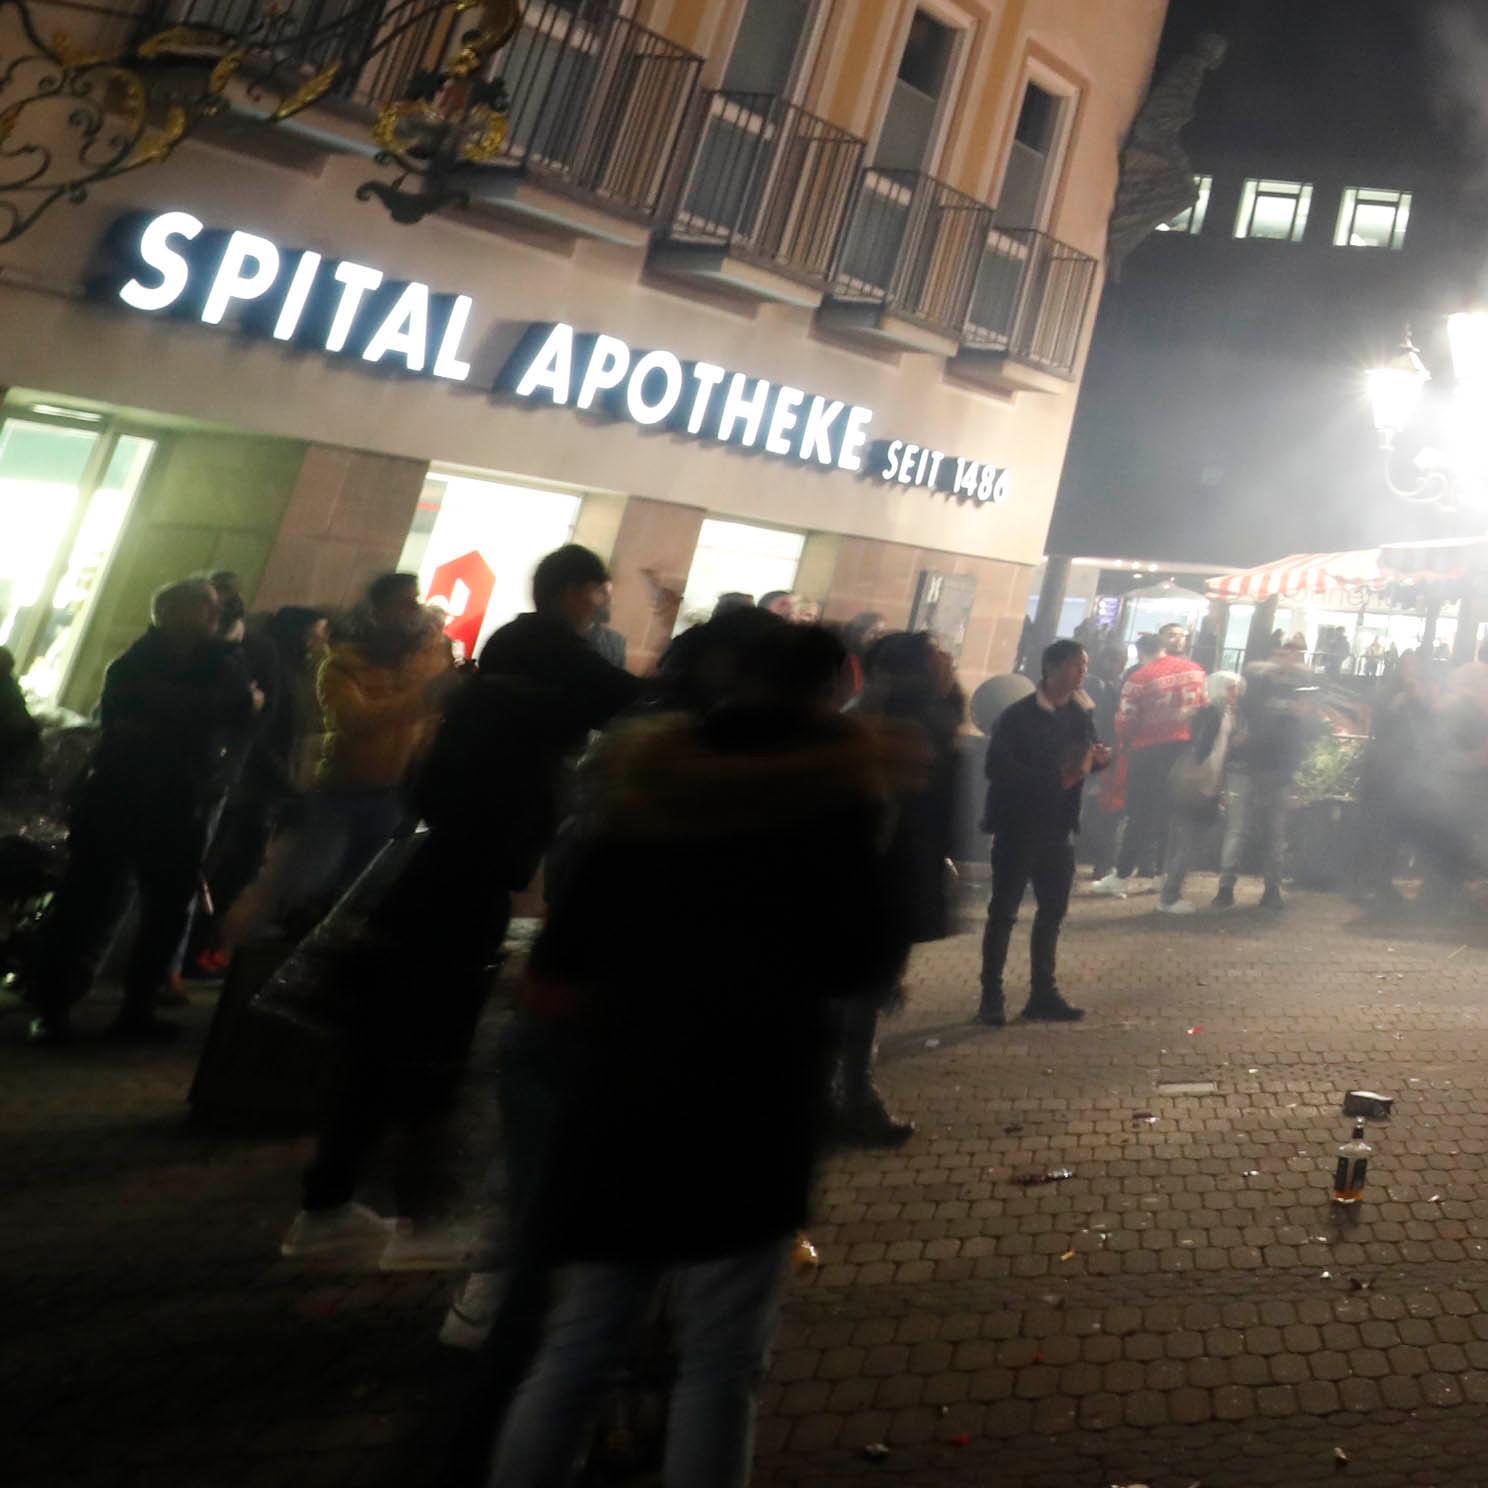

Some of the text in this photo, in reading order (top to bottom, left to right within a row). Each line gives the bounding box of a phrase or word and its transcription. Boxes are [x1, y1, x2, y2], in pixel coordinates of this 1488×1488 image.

[119, 211, 1013, 505] SPITAL APOTHEKE SEIT 1486
